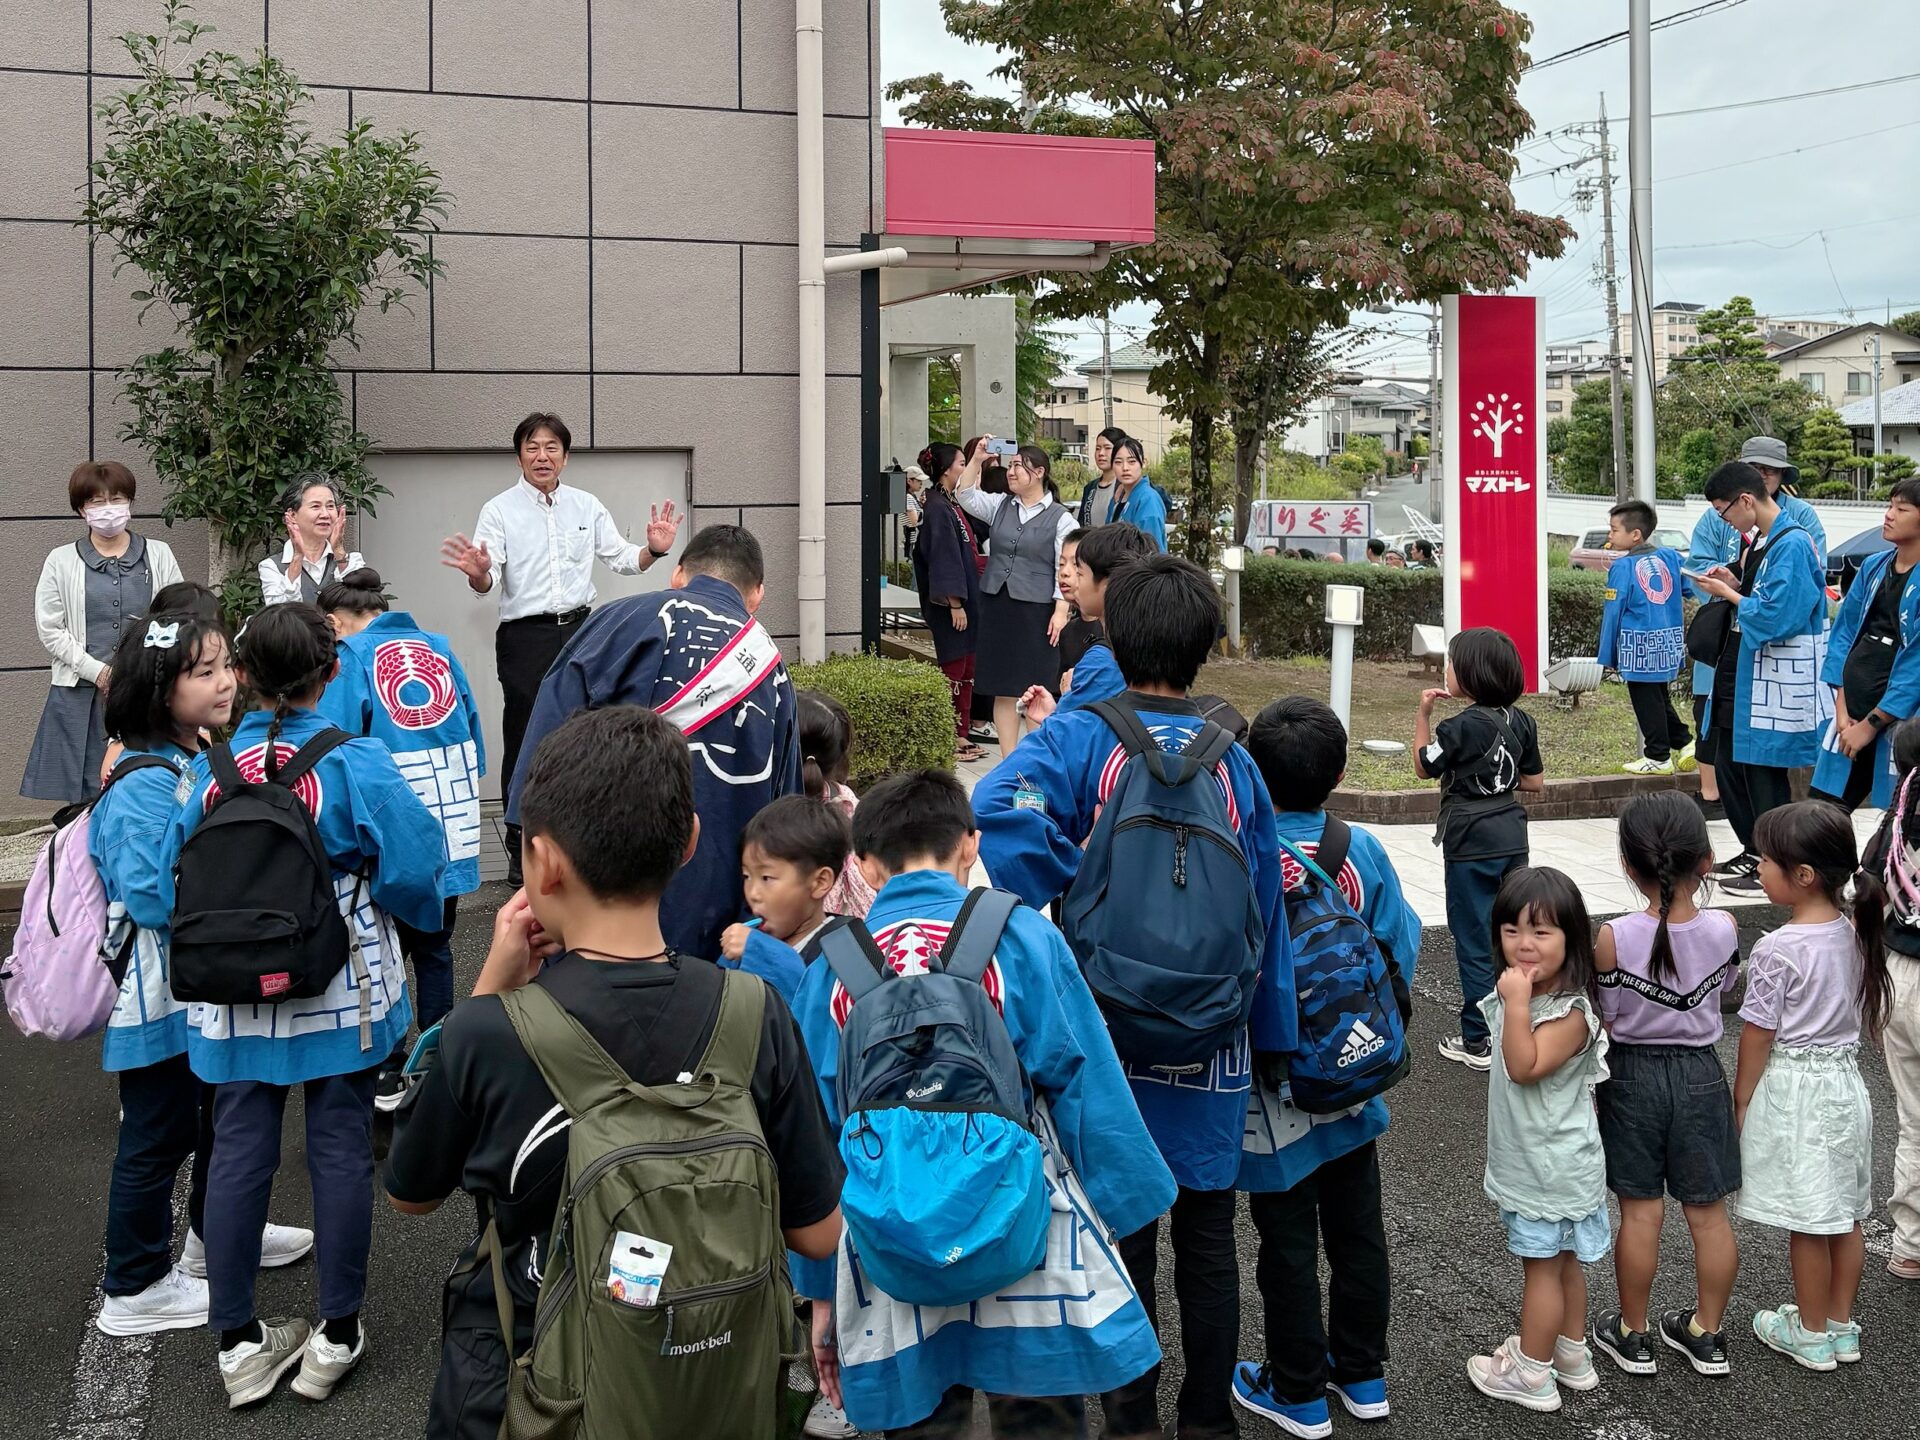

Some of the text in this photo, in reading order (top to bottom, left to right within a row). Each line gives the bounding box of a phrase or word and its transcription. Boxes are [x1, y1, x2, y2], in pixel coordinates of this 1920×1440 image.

[1465, 476, 1531, 493] マストレ
[1687, 972, 1722, 1007] CHEERFUL
[1337, 1035, 1385, 1068] adidas
